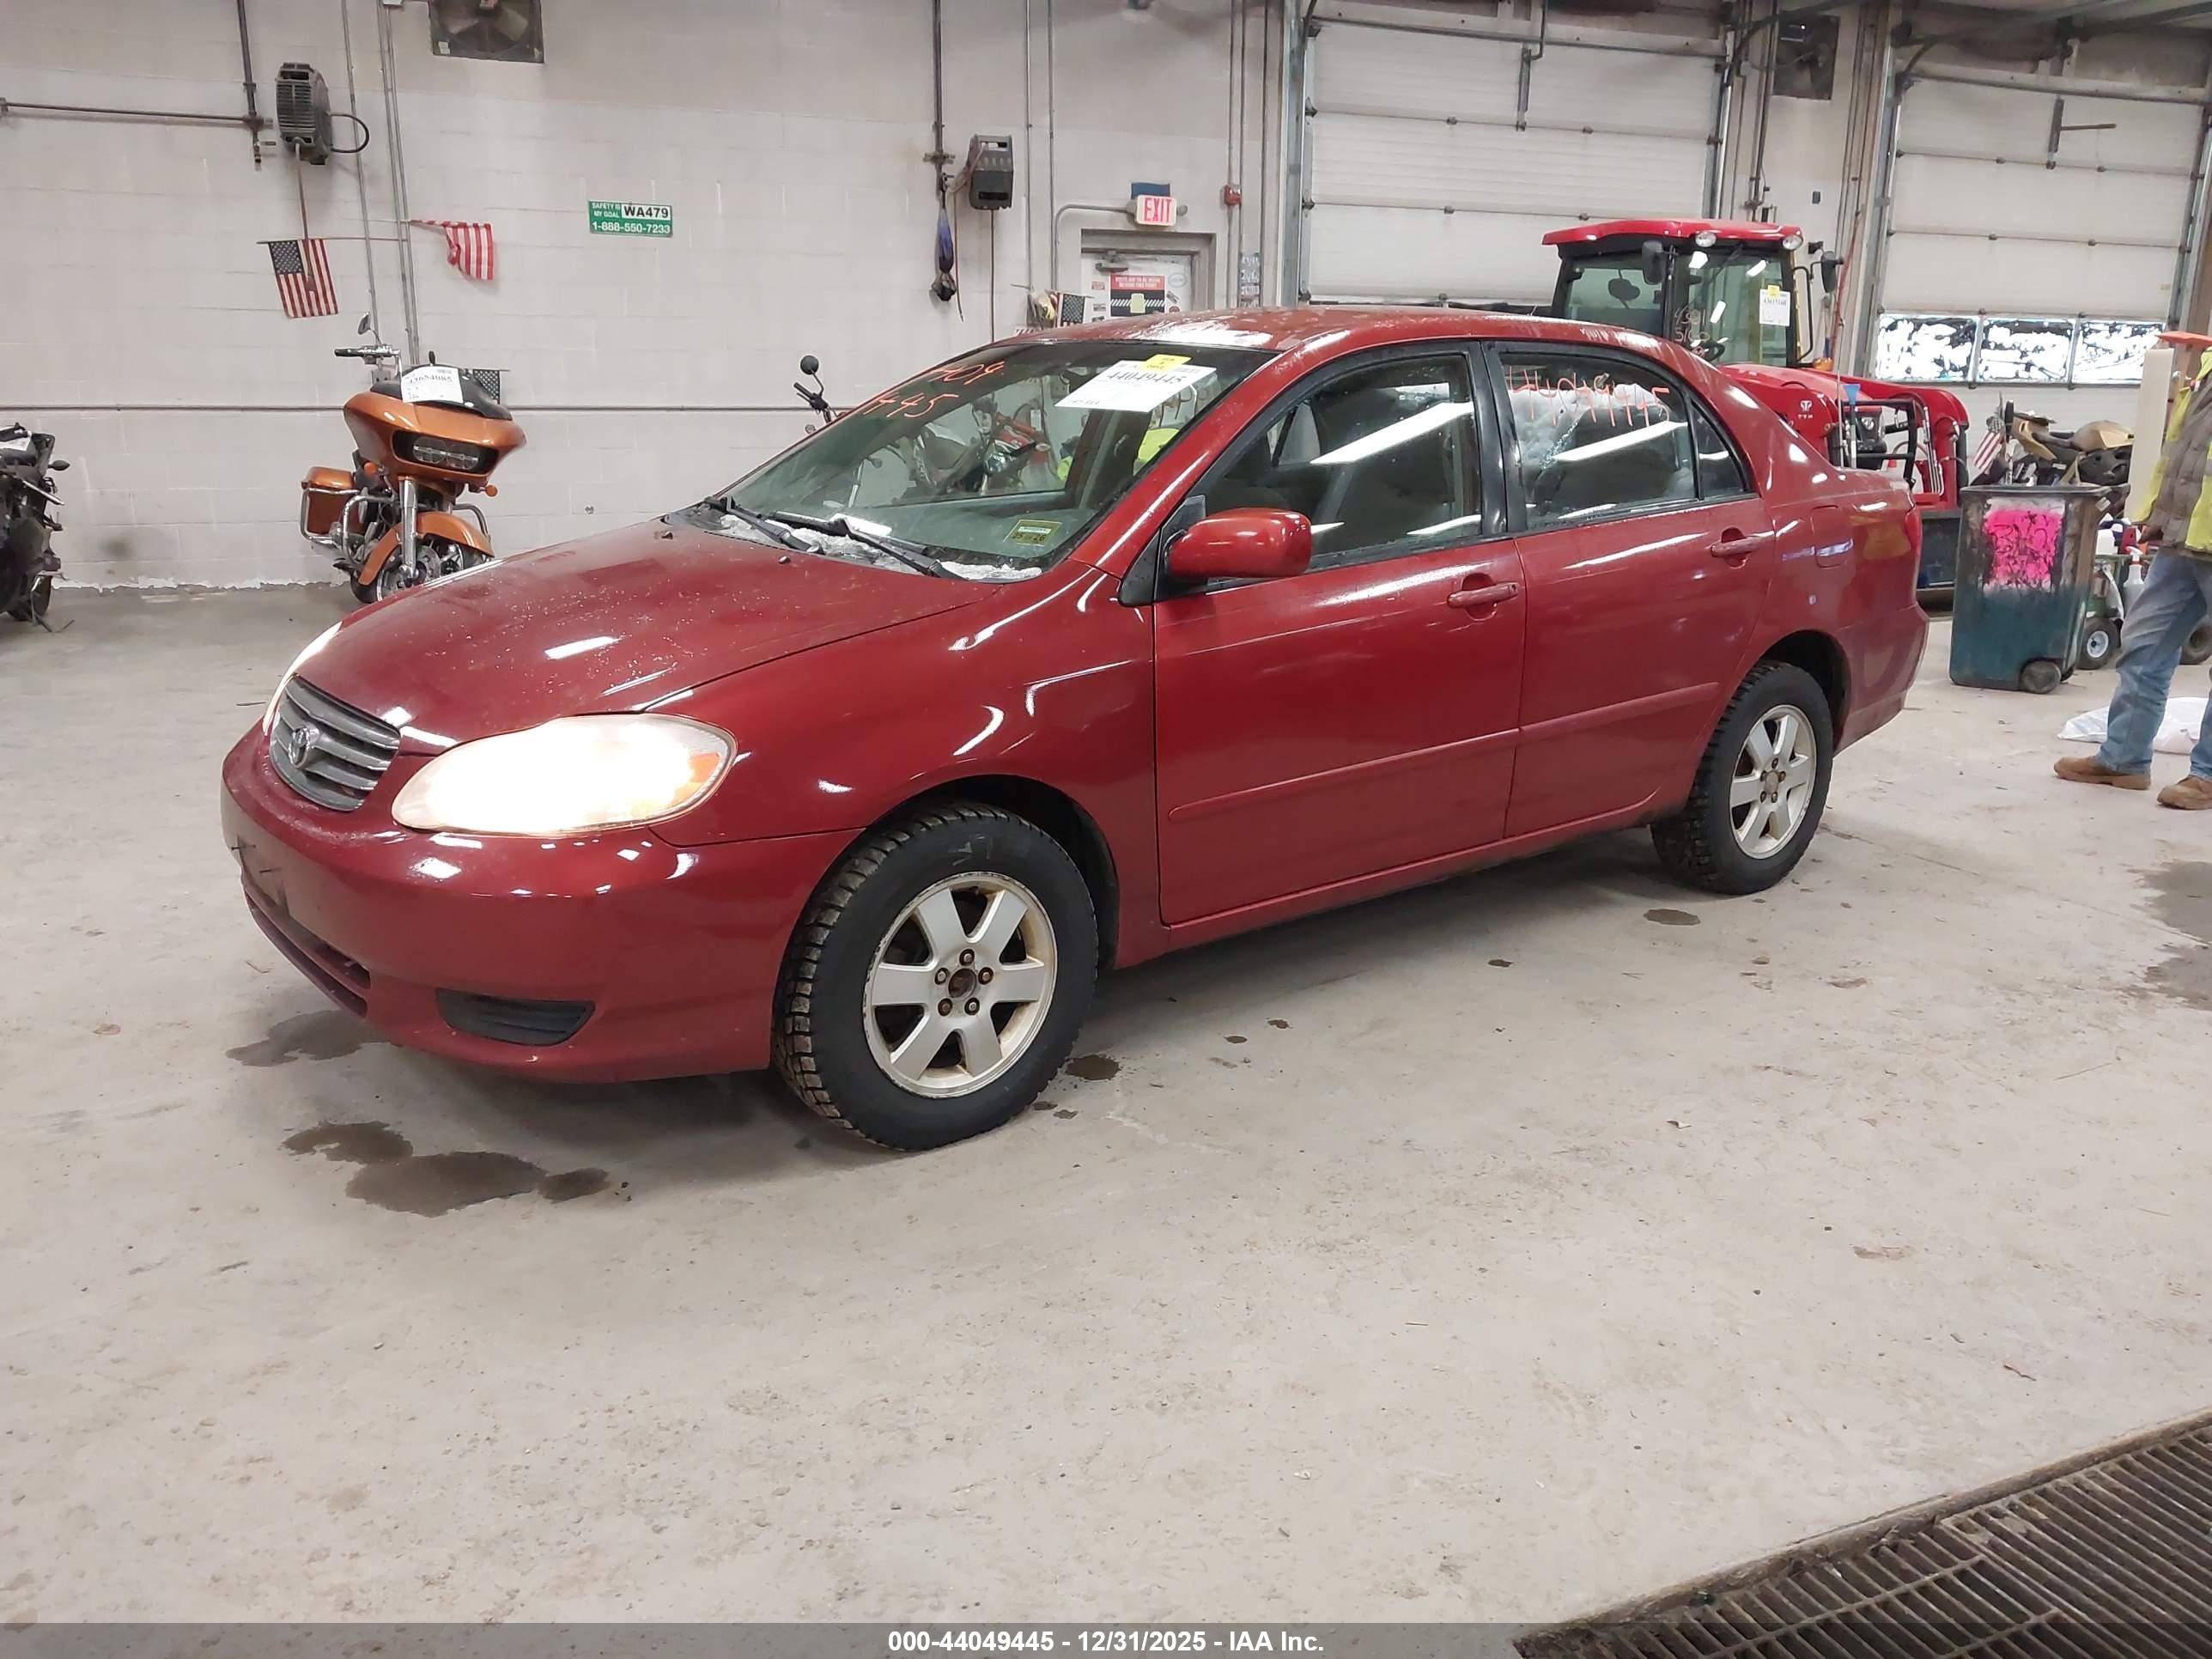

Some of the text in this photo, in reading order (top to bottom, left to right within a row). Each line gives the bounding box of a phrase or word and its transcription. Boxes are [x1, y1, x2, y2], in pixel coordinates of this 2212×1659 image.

[623, 206, 669, 219] WA479
[1144, 198, 1172, 222] EXIT
[592, 221, 671, 234] 1-888-550-7233
[1107, 371, 1188, 385] 44049445
